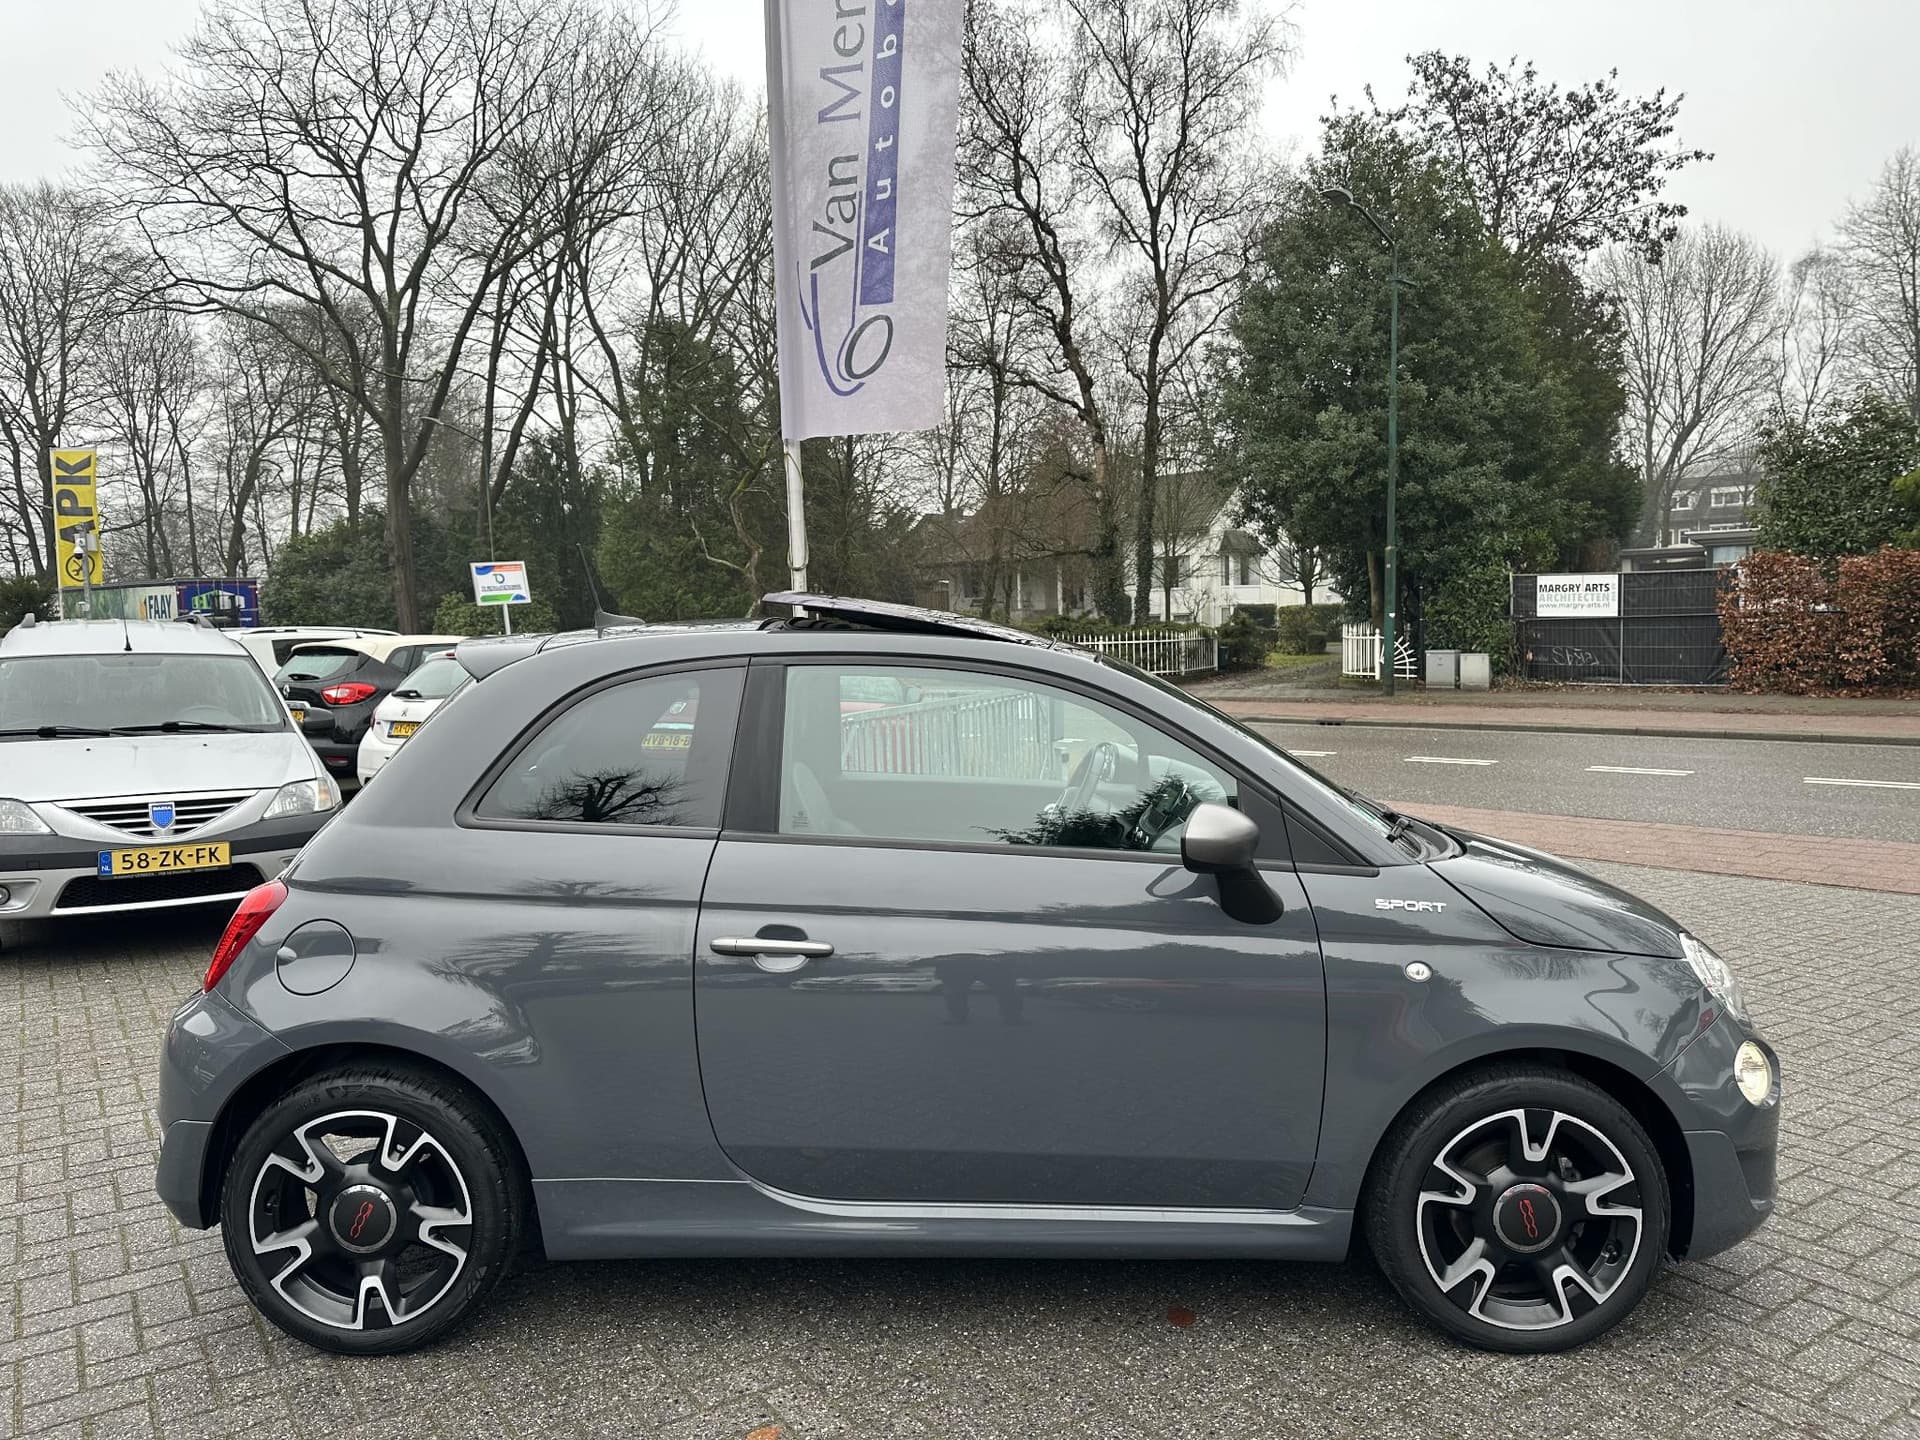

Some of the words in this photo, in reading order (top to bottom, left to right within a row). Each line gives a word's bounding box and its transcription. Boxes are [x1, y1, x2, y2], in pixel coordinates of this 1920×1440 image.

[810, 152, 860, 271] Van
[56, 454, 96, 546] APK
[1539, 584, 1581, 593] MARGRY
[1584, 583, 1610, 592] ARTS
[1539, 592, 1610, 602] ARCHITECTEN
[147, 594, 172, 619] FAAY
[121, 846, 221, 870] 58-ZK-FK
[1374, 898, 1447, 913] SPORT
